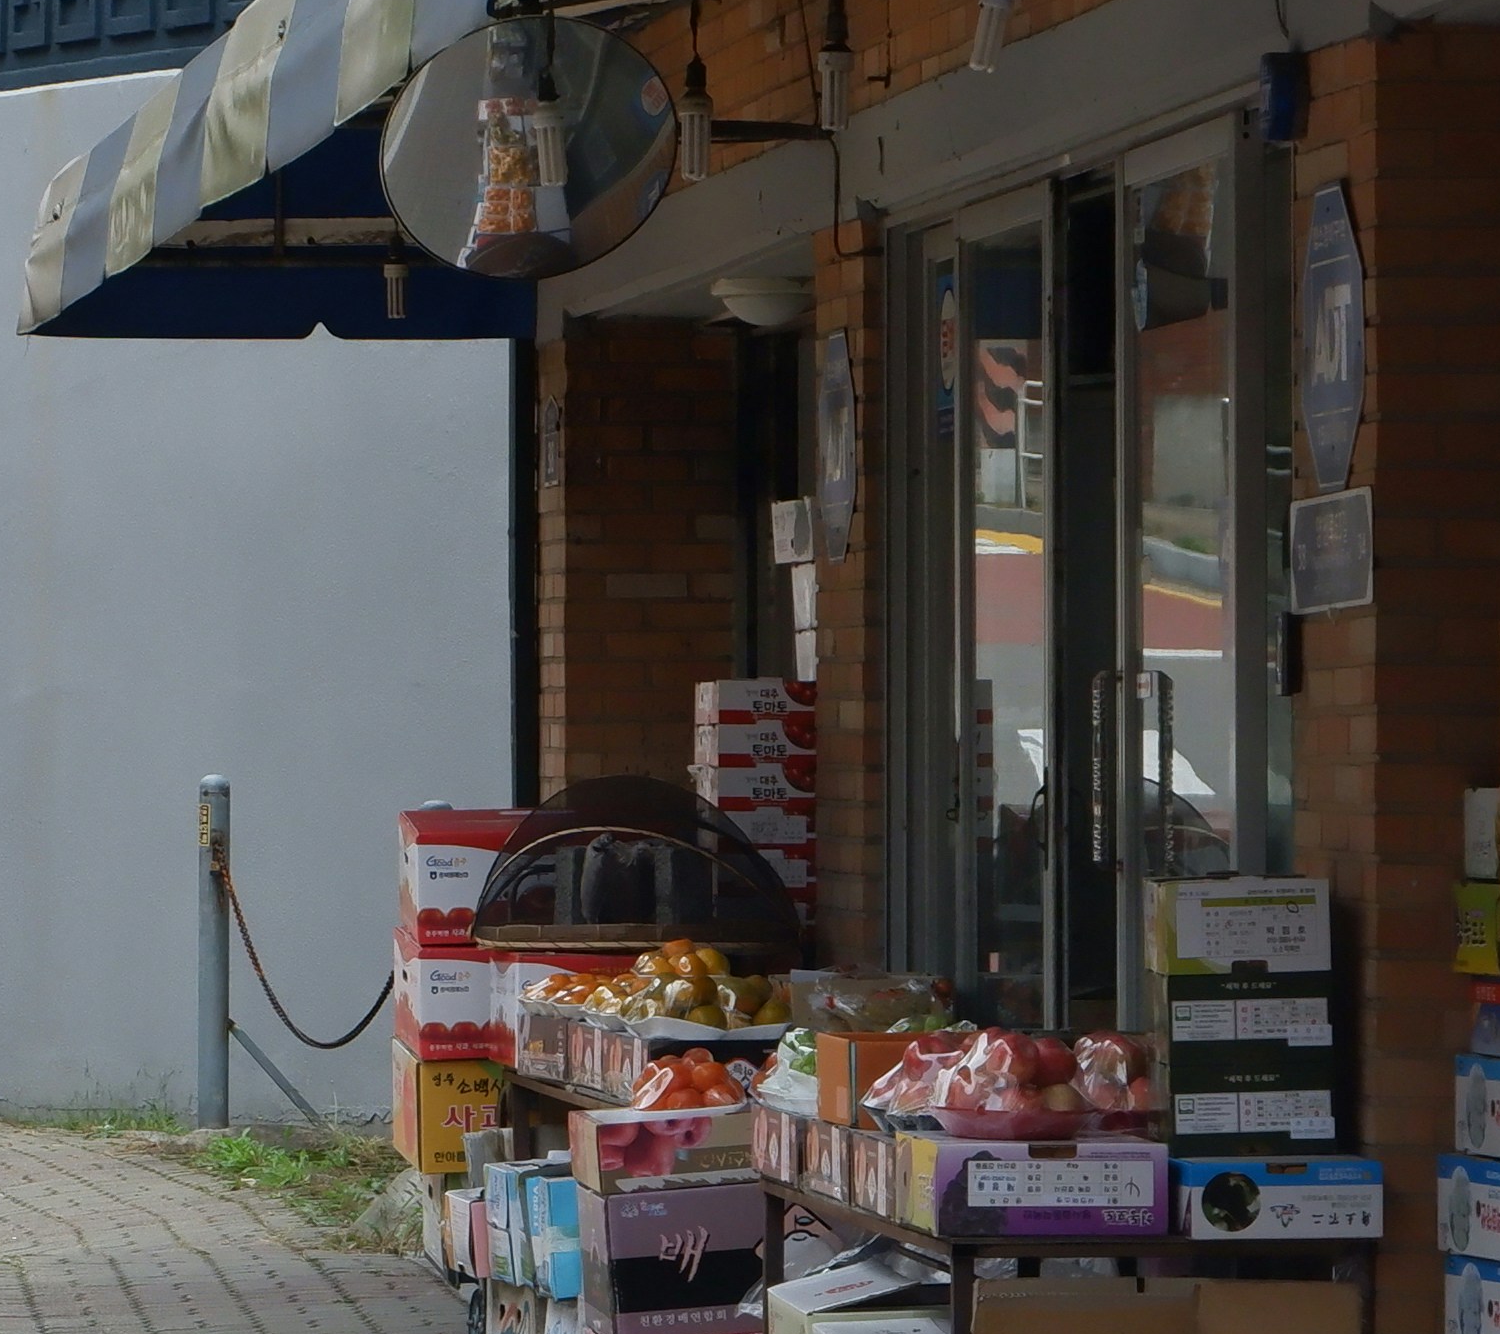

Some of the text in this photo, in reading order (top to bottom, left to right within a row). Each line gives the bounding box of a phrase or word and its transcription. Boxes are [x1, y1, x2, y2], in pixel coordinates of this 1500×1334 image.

[760, 688, 779, 699] 대추
[752, 701, 788, 713] 토마토
[760, 731, 779, 743] 대추
[752, 744, 788, 757] 토마토
[760, 775, 779, 786] 대추
[752, 788, 788, 800] 토마토
[426, 855, 454, 868] Good
[430, 969, 458, 982] Good
[658, 1224, 711, 1284] 배
